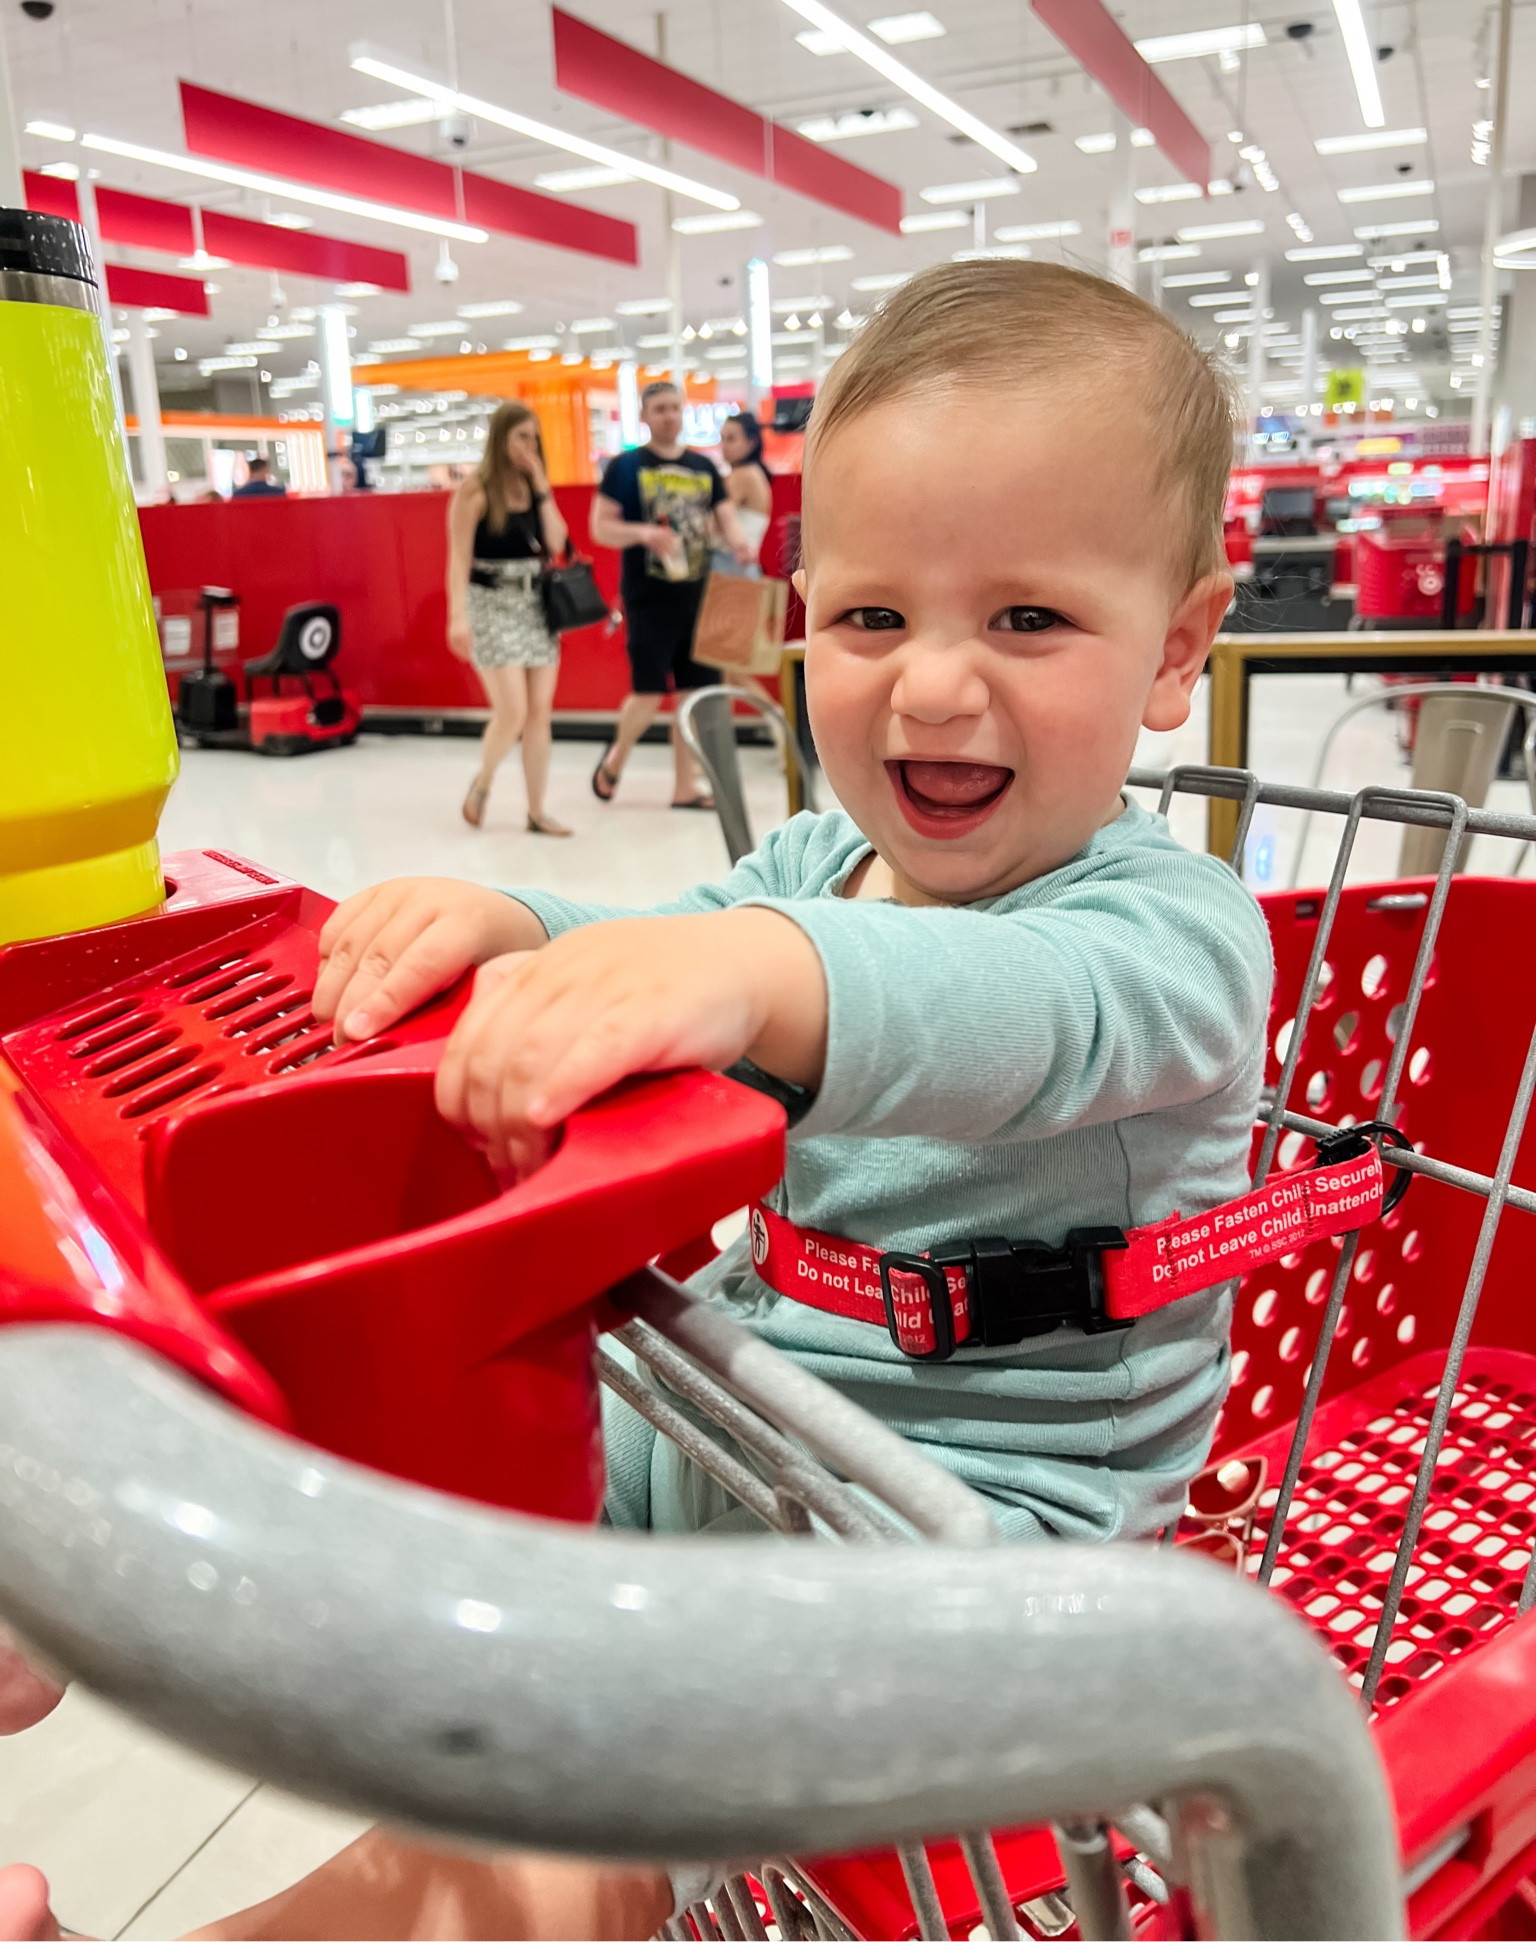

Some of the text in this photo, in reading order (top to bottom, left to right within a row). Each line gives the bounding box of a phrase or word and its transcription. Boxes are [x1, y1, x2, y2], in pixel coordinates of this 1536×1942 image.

[1157, 1225, 1210, 1255] Pease
[1214, 1201, 1268, 1233] Fasten
[1177, 1248, 1205, 1272] not
[1209, 1230, 1257, 1259] Leave
[1261, 1207, 1302, 1237] Child
[805, 1238, 857, 1269] Please
[1249, 1247, 1262, 1258] TM
[797, 1259, 884, 1300] Do not Lea
